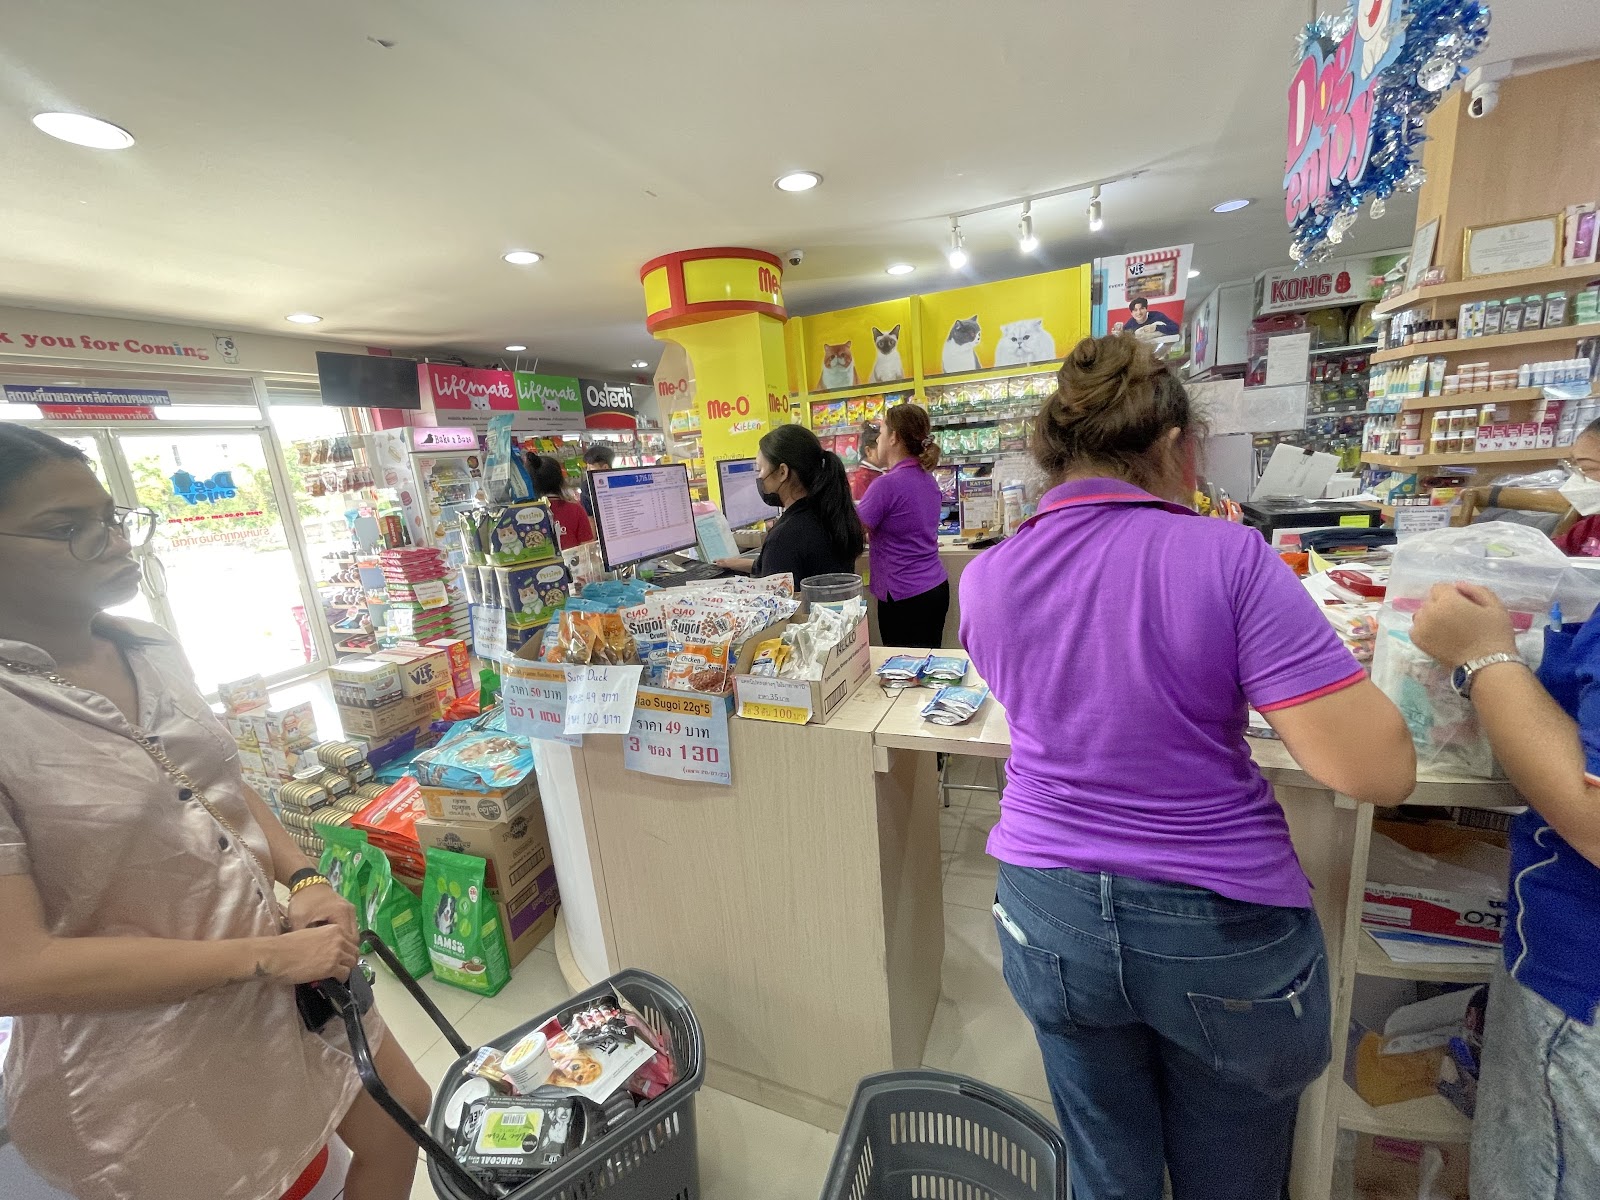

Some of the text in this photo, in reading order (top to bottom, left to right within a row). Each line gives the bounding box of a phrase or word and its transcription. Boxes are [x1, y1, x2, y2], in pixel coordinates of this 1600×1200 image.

[1271, 274, 1333, 304] KONG
[20, 333, 77, 350] you
[79, 335, 120, 352] for
[123, 339, 210, 361] Coming
[733, 422, 762, 432] Kitten
[626, 608, 648, 619] CIAO
[673, 608, 695, 616] CIAO
[629, 617, 663, 635] Sugoi
[670, 619, 701, 635] Sugoi
[681, 655, 701, 664] Chicken
[587, 667, 608, 682] Duck
[510, 684, 562, 701] ราคา 50 บาท
[654, 697, 681, 711] Sugoi
[753, 705, 760, 716] 3
[773, 708, 792, 719] 100
[636, 719, 710, 739] ราคา 49 บาท
[629, 736, 719, 763] 3 ซอง 130
[433, 933, 459, 952] IAMS
[480, 1156, 524, 1166] CHARCOAL
